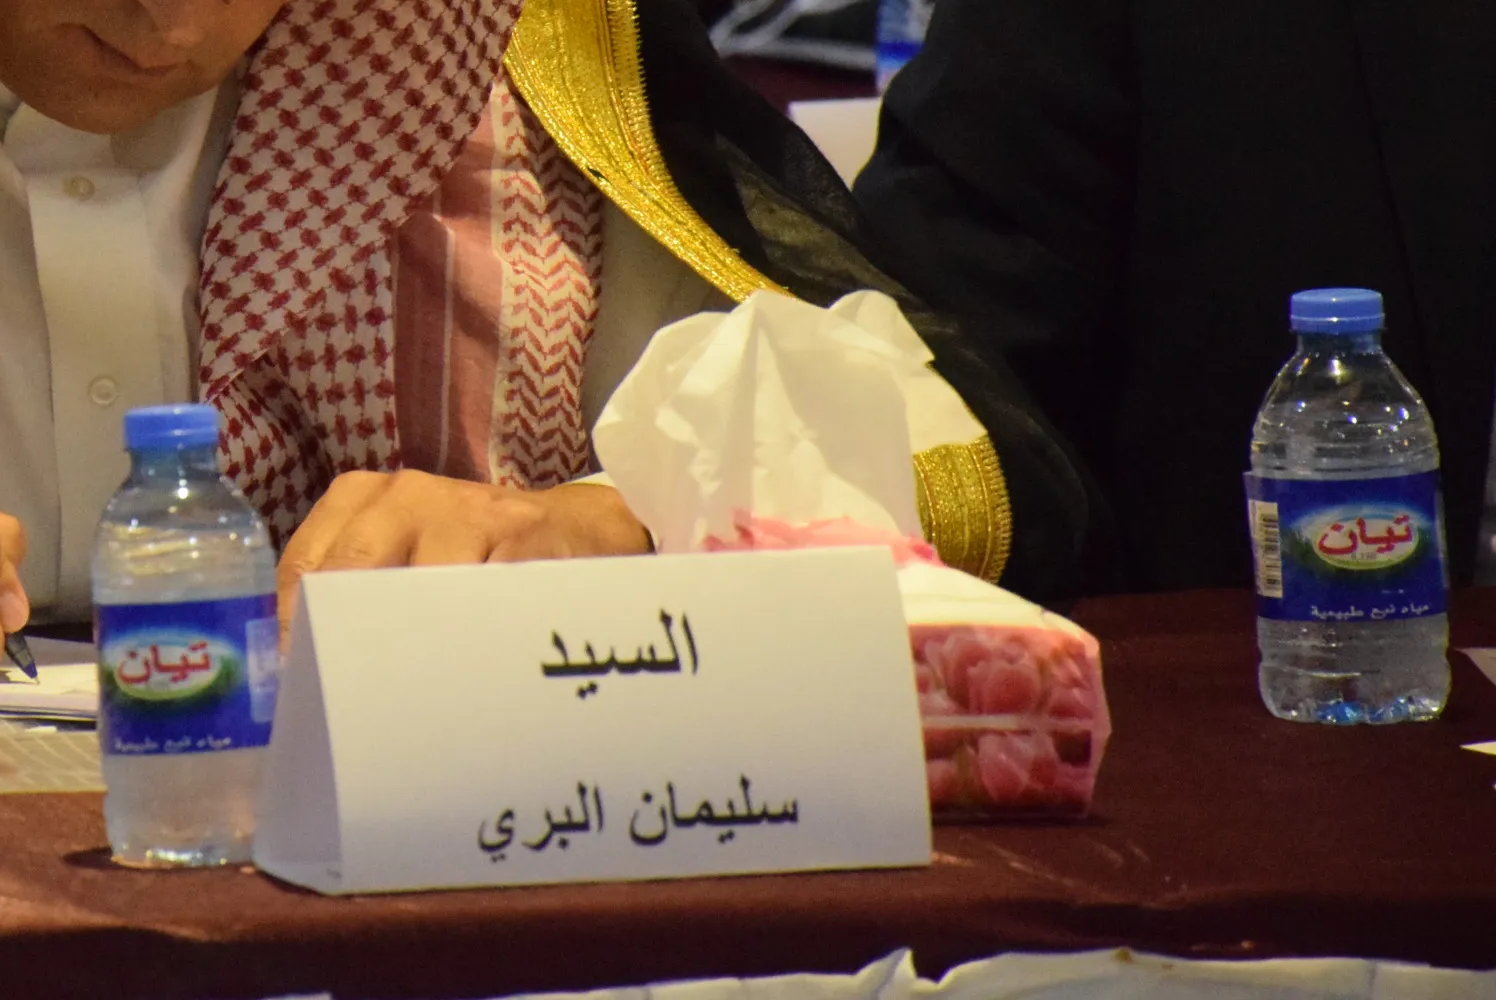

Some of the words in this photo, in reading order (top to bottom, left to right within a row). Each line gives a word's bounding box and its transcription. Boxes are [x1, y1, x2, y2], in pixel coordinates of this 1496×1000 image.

[1317, 514, 1413, 556] تيان
[117, 641, 212, 685] تيان
[541, 608, 698, 700] السيد
[477, 781, 604, 863] البري
[629, 773, 799, 846] سليمان
